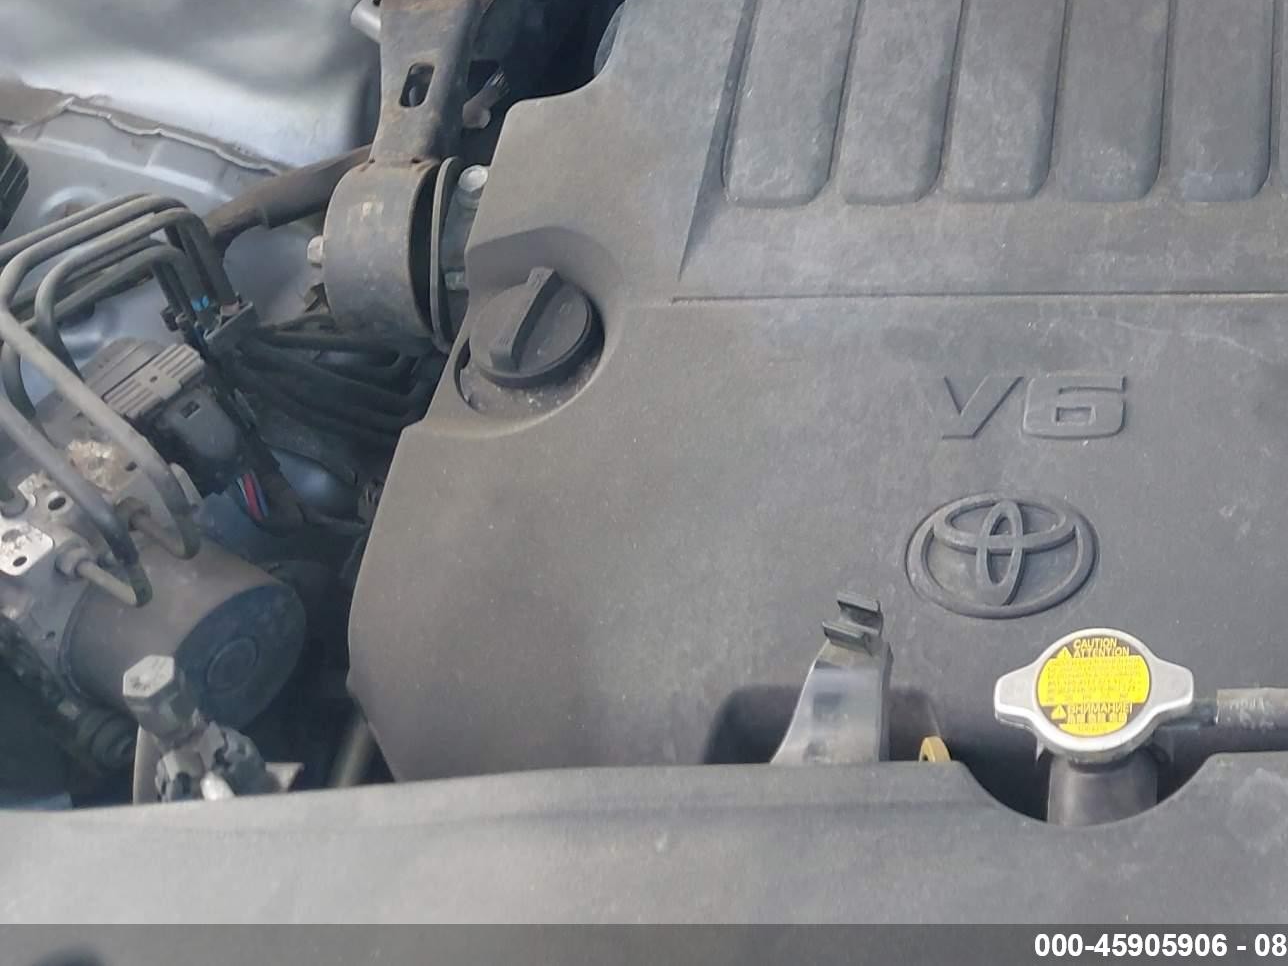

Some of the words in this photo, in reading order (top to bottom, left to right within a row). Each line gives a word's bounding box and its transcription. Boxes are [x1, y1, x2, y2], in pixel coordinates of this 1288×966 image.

[922, 372, 1128, 441] V6
[1073, 638, 1117, 648] CAUTION
[1073, 646, 1130, 658] ATTENTION
